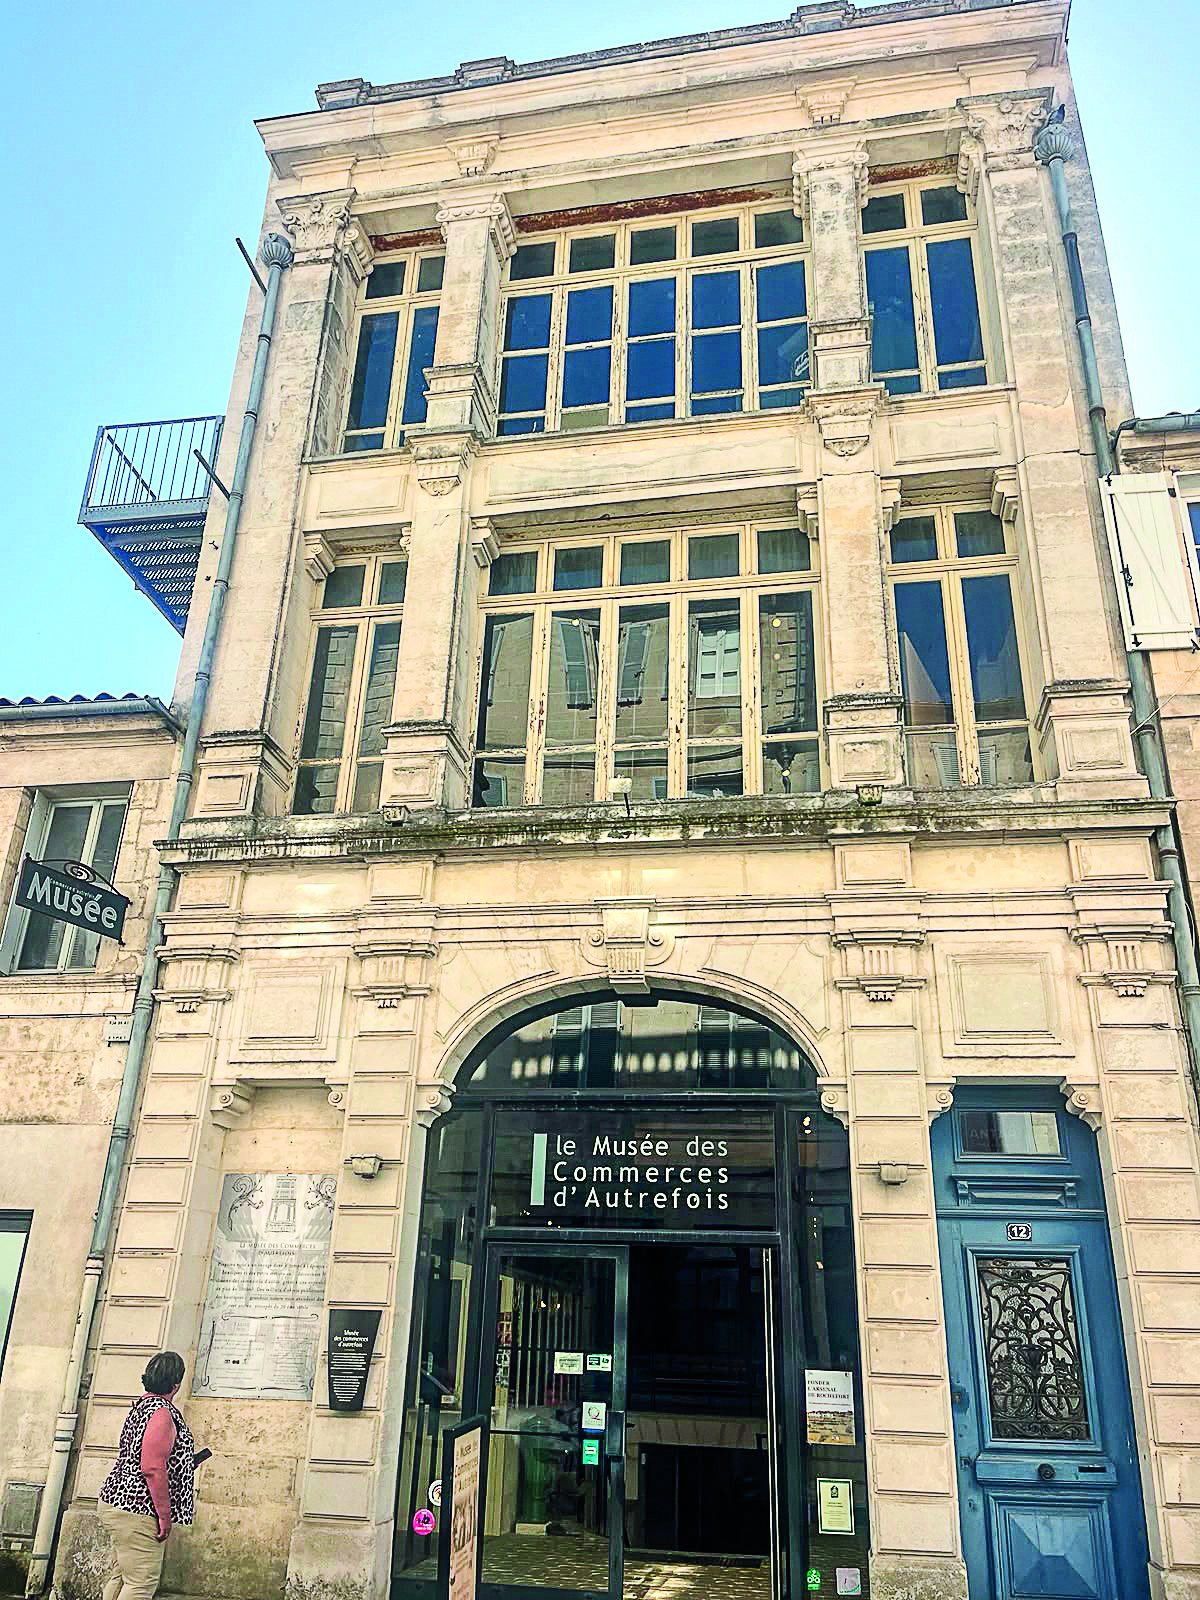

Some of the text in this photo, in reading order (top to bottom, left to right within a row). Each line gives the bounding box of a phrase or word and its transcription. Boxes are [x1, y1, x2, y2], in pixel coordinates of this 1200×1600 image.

[26, 871, 118, 929] Musée
[556, 1133, 728, 1157] le Musée des
[553, 1161, 729, 1184] Commerces
[1011, 1226, 1028, 1238] 12
